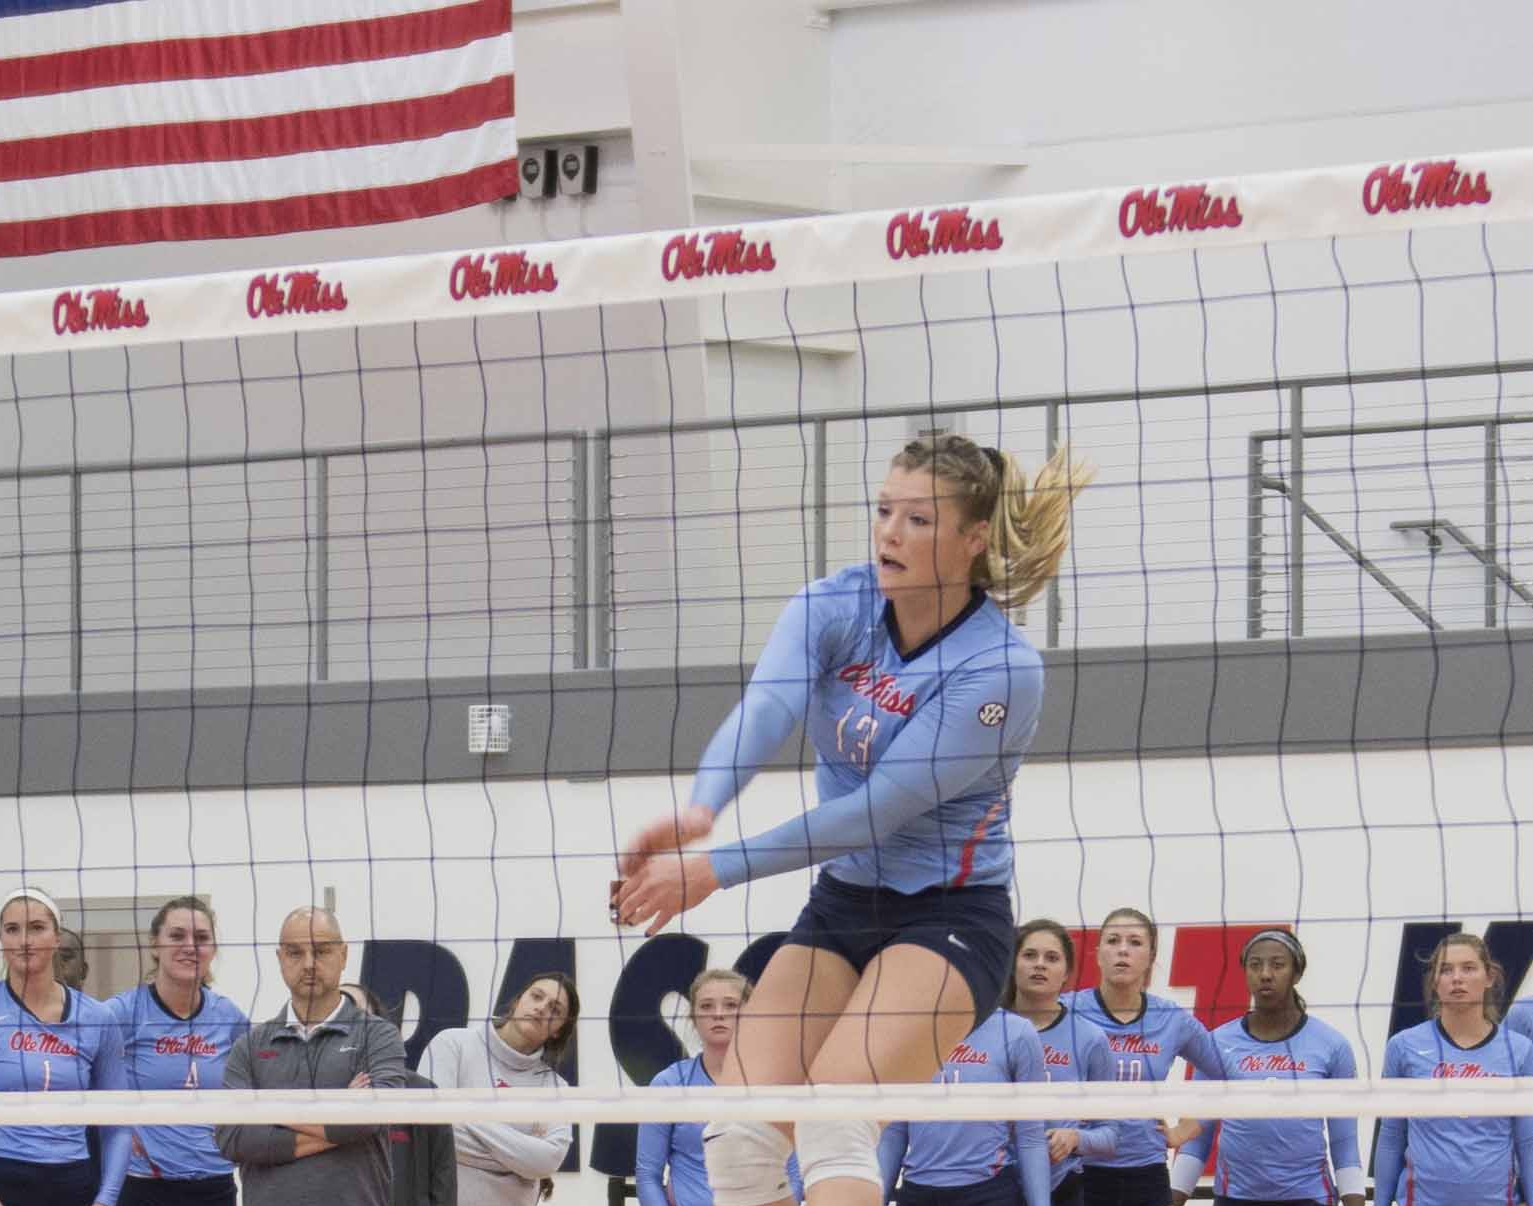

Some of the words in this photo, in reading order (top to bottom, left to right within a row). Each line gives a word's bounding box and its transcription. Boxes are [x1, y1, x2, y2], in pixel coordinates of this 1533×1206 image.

[1362, 165, 1412, 215] Ole
[1410, 159, 1493, 209] Miss
[886, 212, 930, 261] Ole
[927, 207, 1003, 254] Miss
[1118, 190, 1166, 239] Ole
[1163, 186, 1243, 231] Miss
[449, 255, 492, 302] Ole
[489, 252, 557, 296] Miss
[661, 234, 705, 281] Ole
[703, 231, 777, 274] Miss
[52, 291, 88, 335] Ole
[86, 288, 149, 330] Miss
[246, 274, 284, 320] Ole
[284, 271, 348, 314] Miss
[979, 702, 1006, 727] SEC
[836, 704, 881, 774] 13
[9, 1030, 37, 1052] Ole
[36, 1032, 81, 1057] Miss
[154, 1035, 182, 1055] Ole
[180, 1031, 219, 1057] Miss
[948, 1042, 989, 1065] Miss
[1108, 1035, 1123, 1054] le
[1122, 1033, 1162, 1056] Miss
[1239, 1055, 1265, 1072] Ole
[1264, 1054, 1307, 1072] Miss
[183, 1060, 199, 1090] 4
